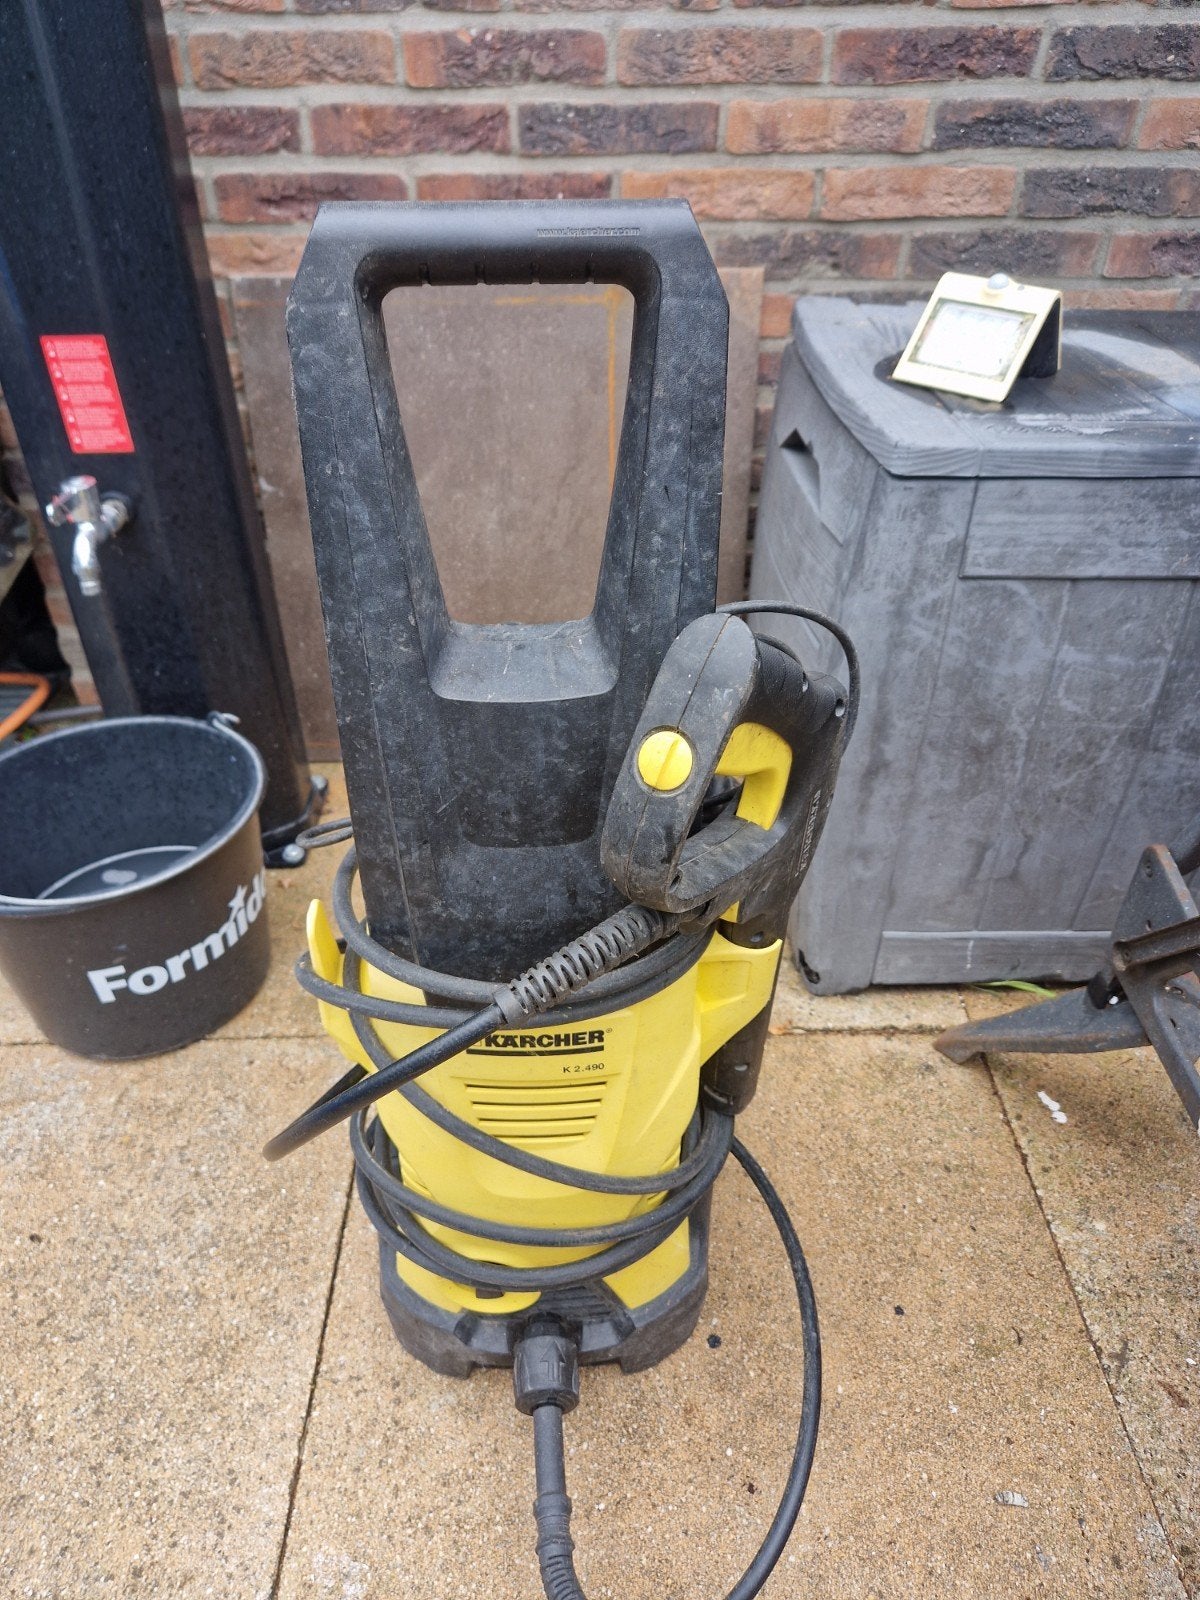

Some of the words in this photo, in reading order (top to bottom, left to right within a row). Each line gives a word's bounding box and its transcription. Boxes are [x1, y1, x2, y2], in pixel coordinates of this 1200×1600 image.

[87, 867, 266, 1005] Formid
[562, 1065, 571, 1074] K
[574, 1062, 605, 1073] 2.490
